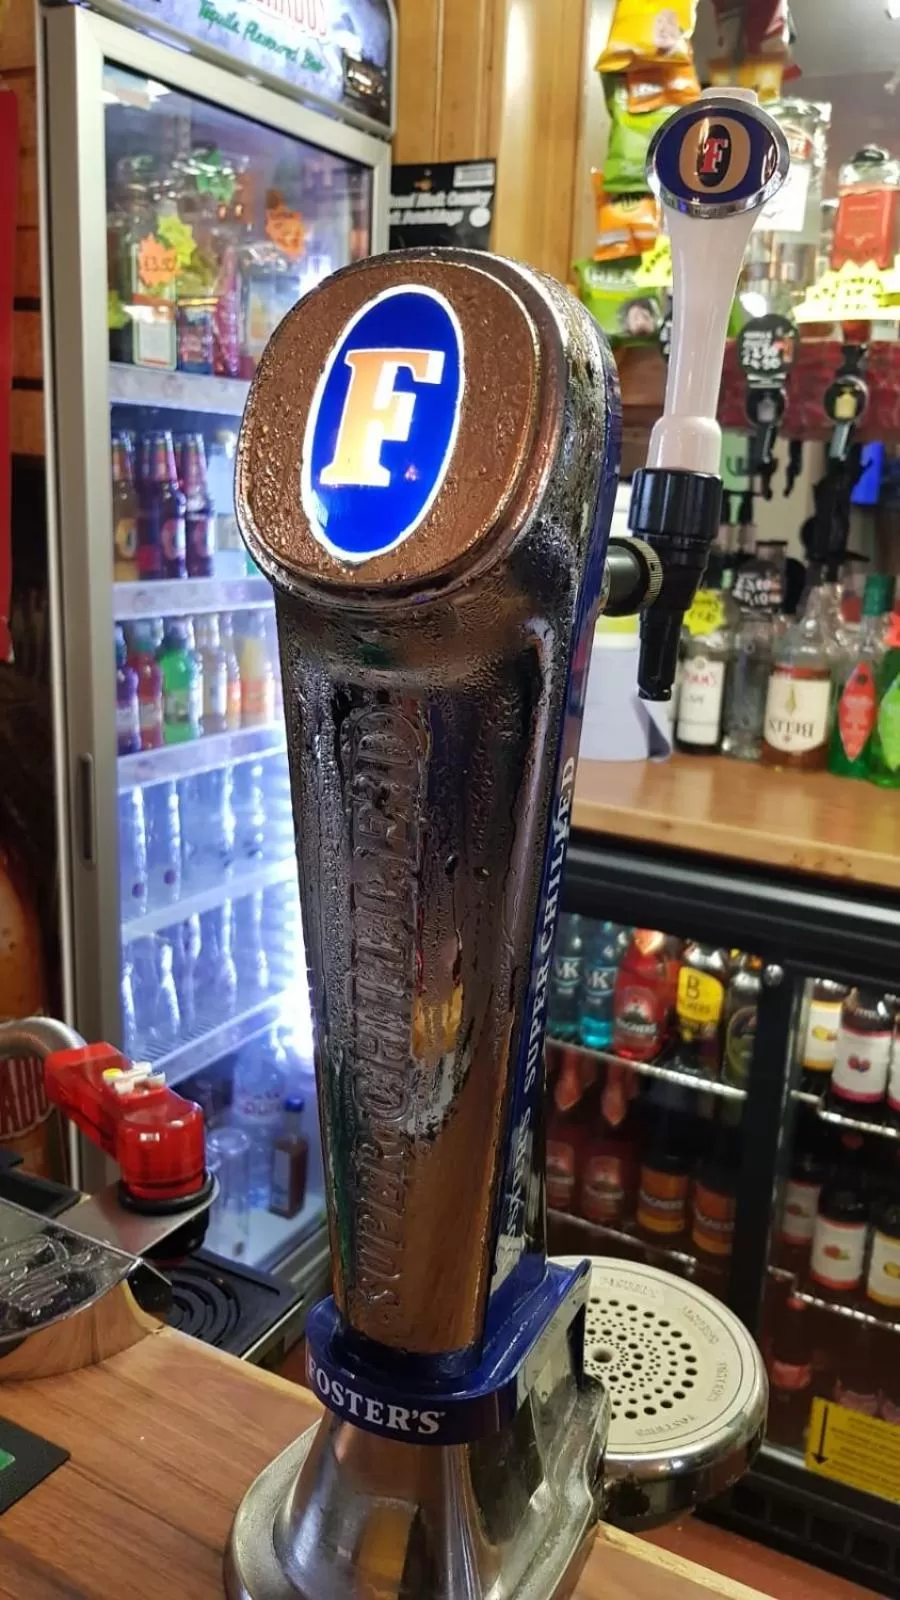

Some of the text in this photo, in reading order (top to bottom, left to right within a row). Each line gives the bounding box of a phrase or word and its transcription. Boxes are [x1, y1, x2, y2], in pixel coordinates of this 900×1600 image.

[197, 1, 240, 34] Tequila
[319, 347, 447, 488] F
[307, 1351, 441, 1435] FOSTER'S
